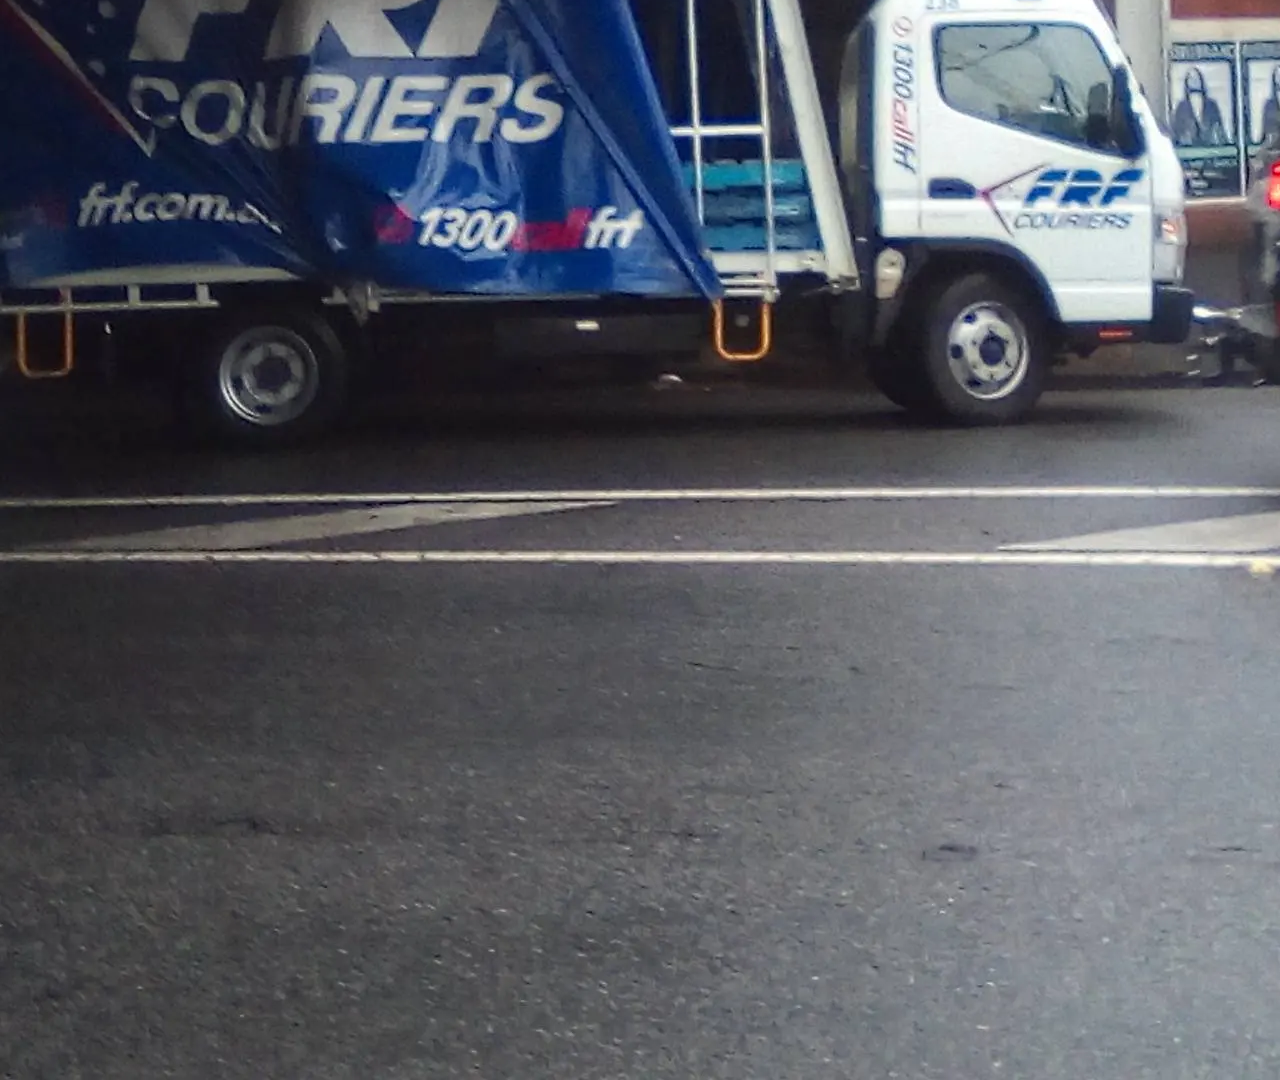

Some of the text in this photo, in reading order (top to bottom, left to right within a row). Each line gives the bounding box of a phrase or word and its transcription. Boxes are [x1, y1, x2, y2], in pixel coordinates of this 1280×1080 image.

[128, 73, 565, 152] COURIERS
[1023, 168, 1145, 208] FRF
[1013, 211, 1135, 231] COURIERS
